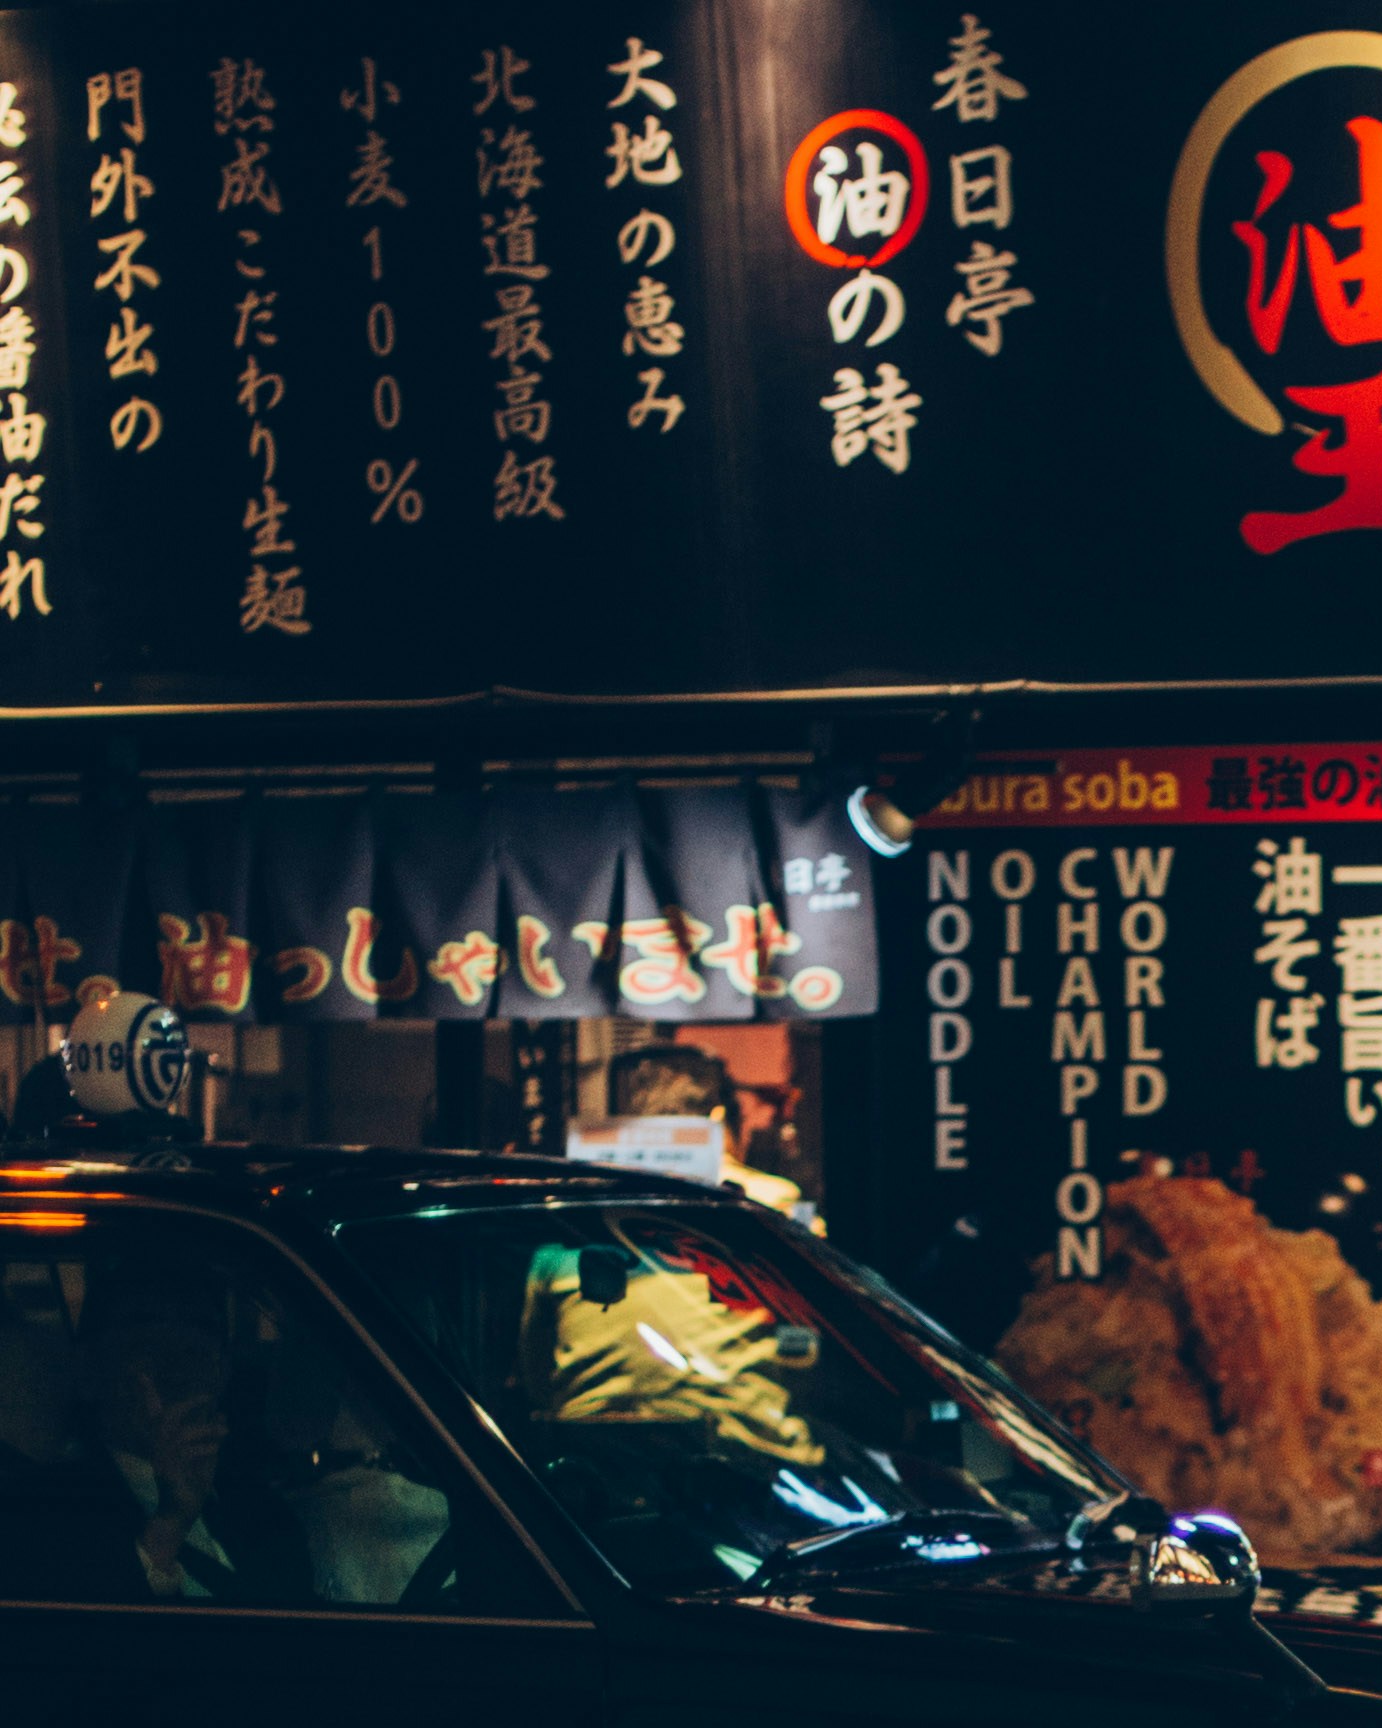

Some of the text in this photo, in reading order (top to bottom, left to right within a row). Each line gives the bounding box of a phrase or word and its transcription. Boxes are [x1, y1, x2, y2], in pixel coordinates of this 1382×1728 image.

[88, 66, 162, 455] 門外不出の
[209, 57, 311, 635] 熟成こだわり生麺
[340, 57, 424, 524] 小麦100%
[472, 46, 565, 522] 北海道最高級
[605, 37, 685, 433] 大地の恵み
[812, 142, 924, 475] 油の詩
[931, 13, 1035, 356] 春日亭
[991, 850, 1035, 1010] OIL
[1062, 760, 1180, 811] soba
[1253, 836, 1324, 1070] 油そば
[67, 1041, 125, 1072] 019
[927, 850, 973, 1172] NOODLE
[1052, 848, 1106, 1279] CHAMPION
[1112, 846, 1174, 1117] WORLD
